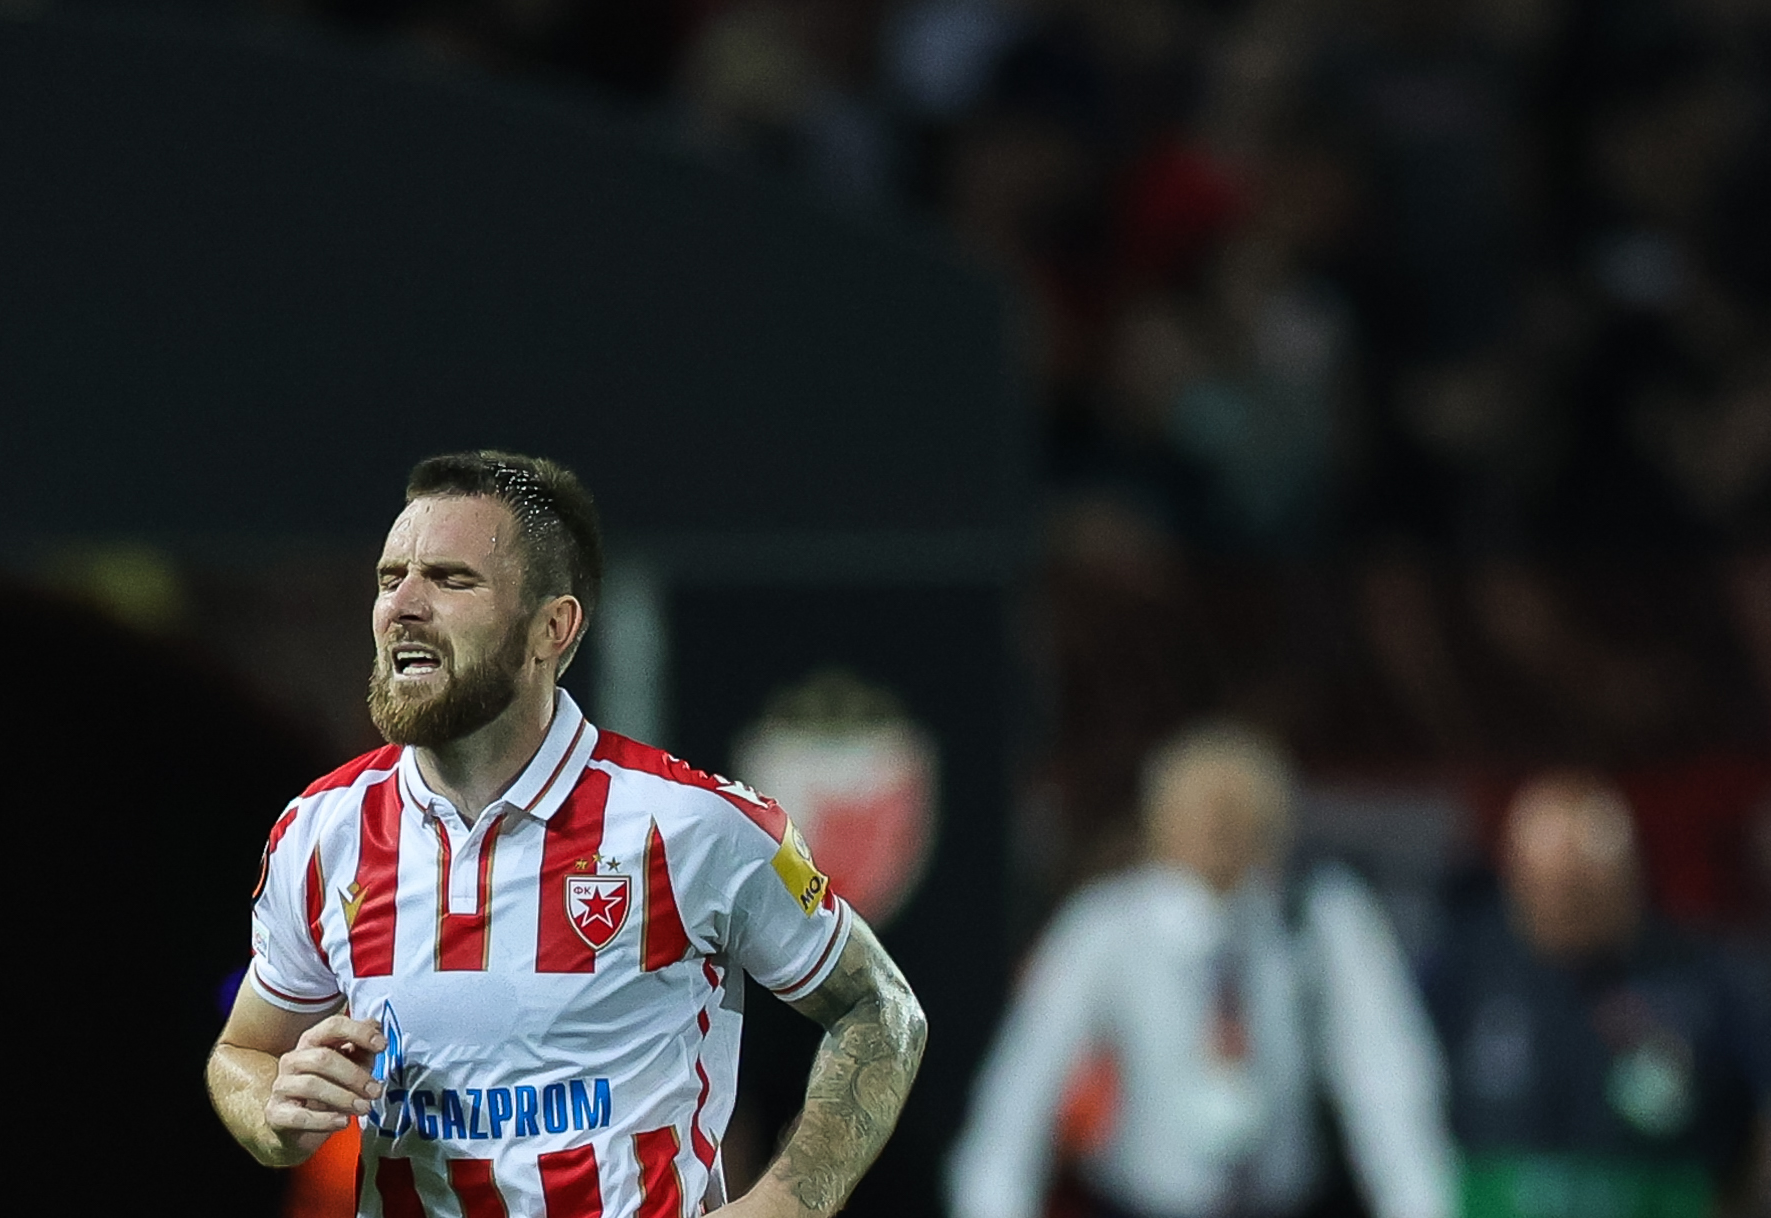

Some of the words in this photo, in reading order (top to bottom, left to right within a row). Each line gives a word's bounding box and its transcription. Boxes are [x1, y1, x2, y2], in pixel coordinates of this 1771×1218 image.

[573, 886, 592, 896] ФК
[800, 875, 825, 910] MO
[415, 1077, 612, 1141] GAZPROM
